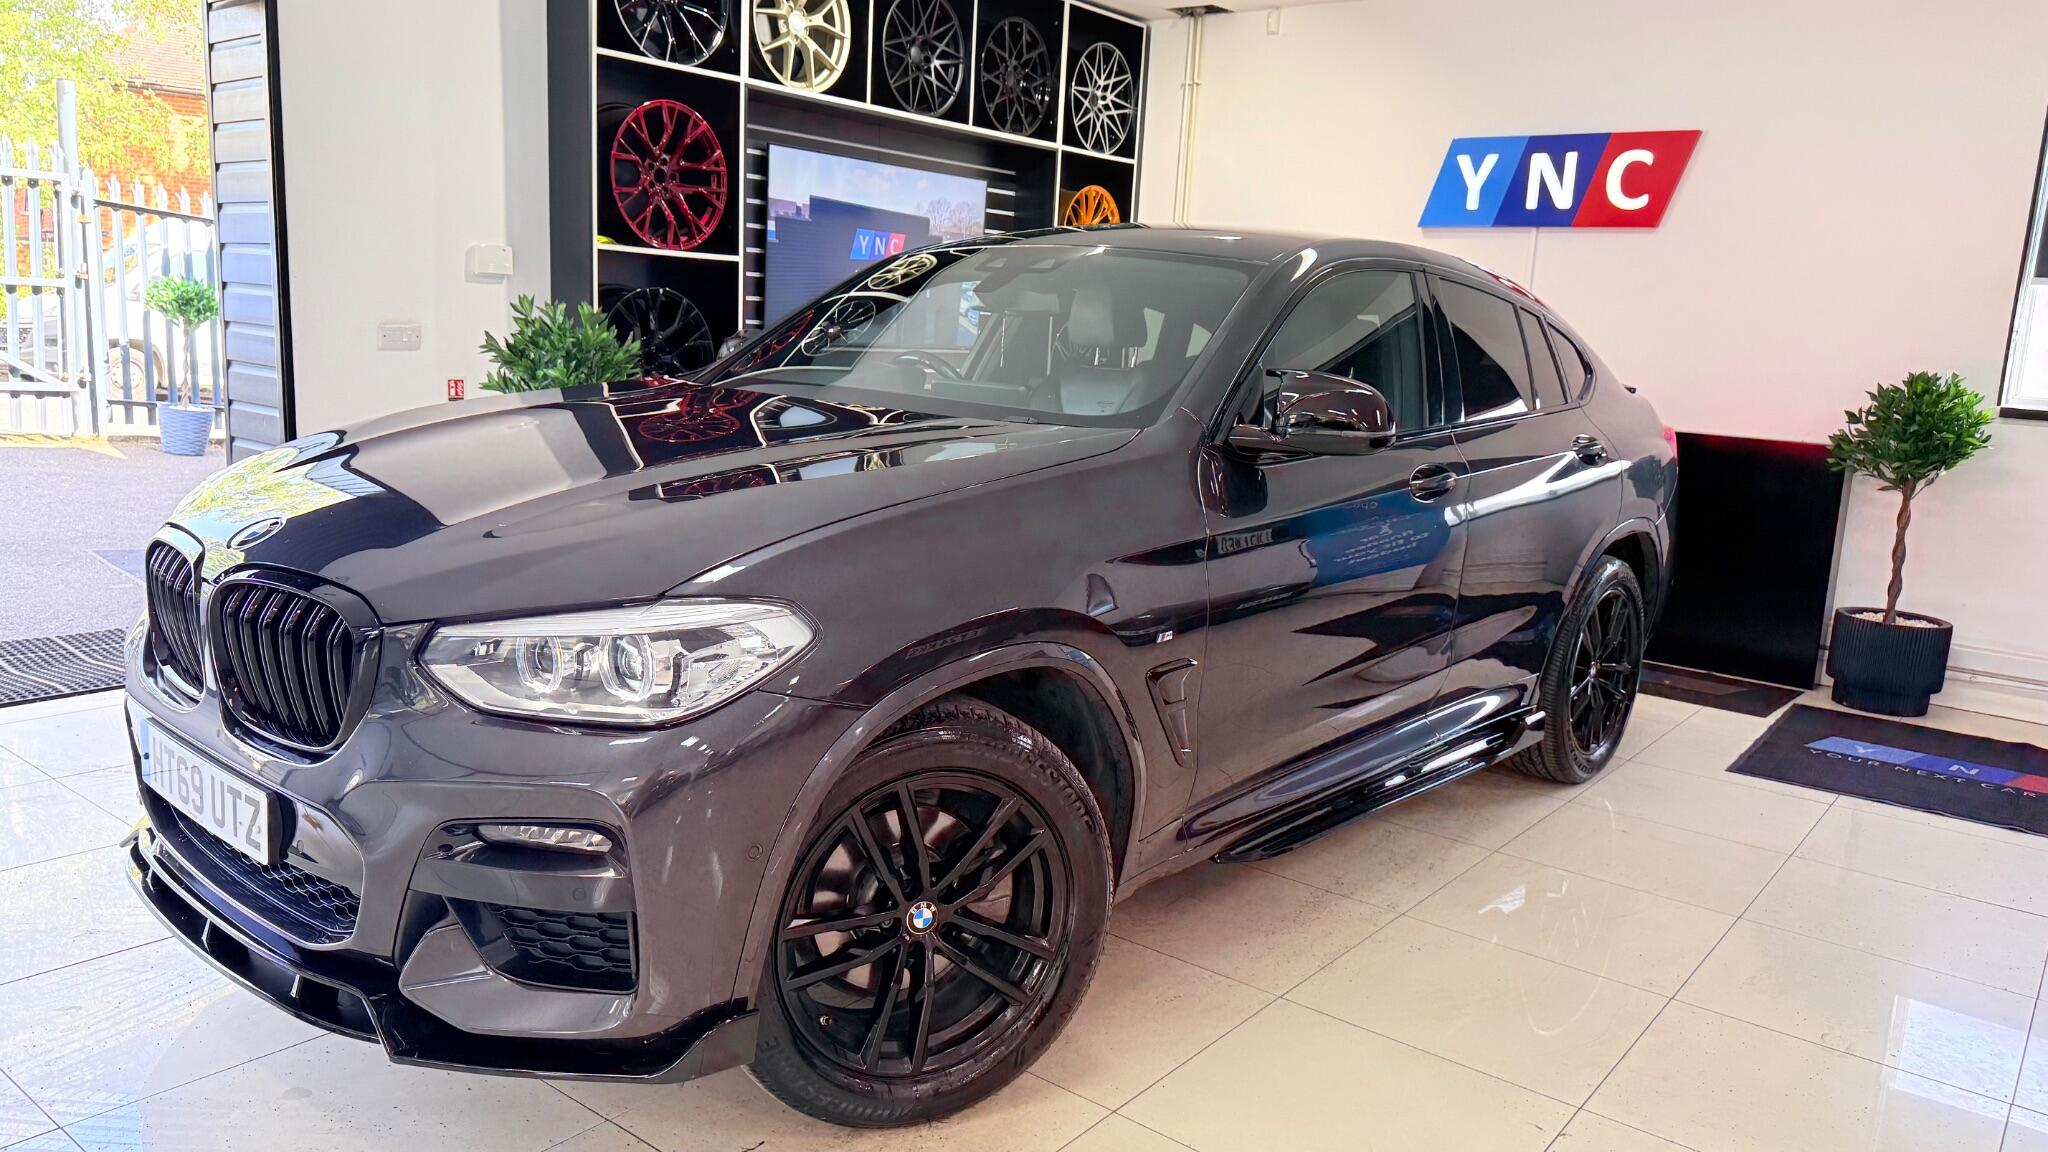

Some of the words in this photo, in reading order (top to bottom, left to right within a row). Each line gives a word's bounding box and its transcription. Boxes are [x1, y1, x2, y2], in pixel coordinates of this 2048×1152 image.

[1456, 149, 1654, 211] YNC
[859, 234, 900, 256] YNC
[152, 736, 204, 815] HT69
[211, 775, 261, 852] UTZ
[1809, 747, 1880, 767] YOUR
[1894, 765, 1967, 783] NEXT
[1980, 782, 2036, 798] CAR
